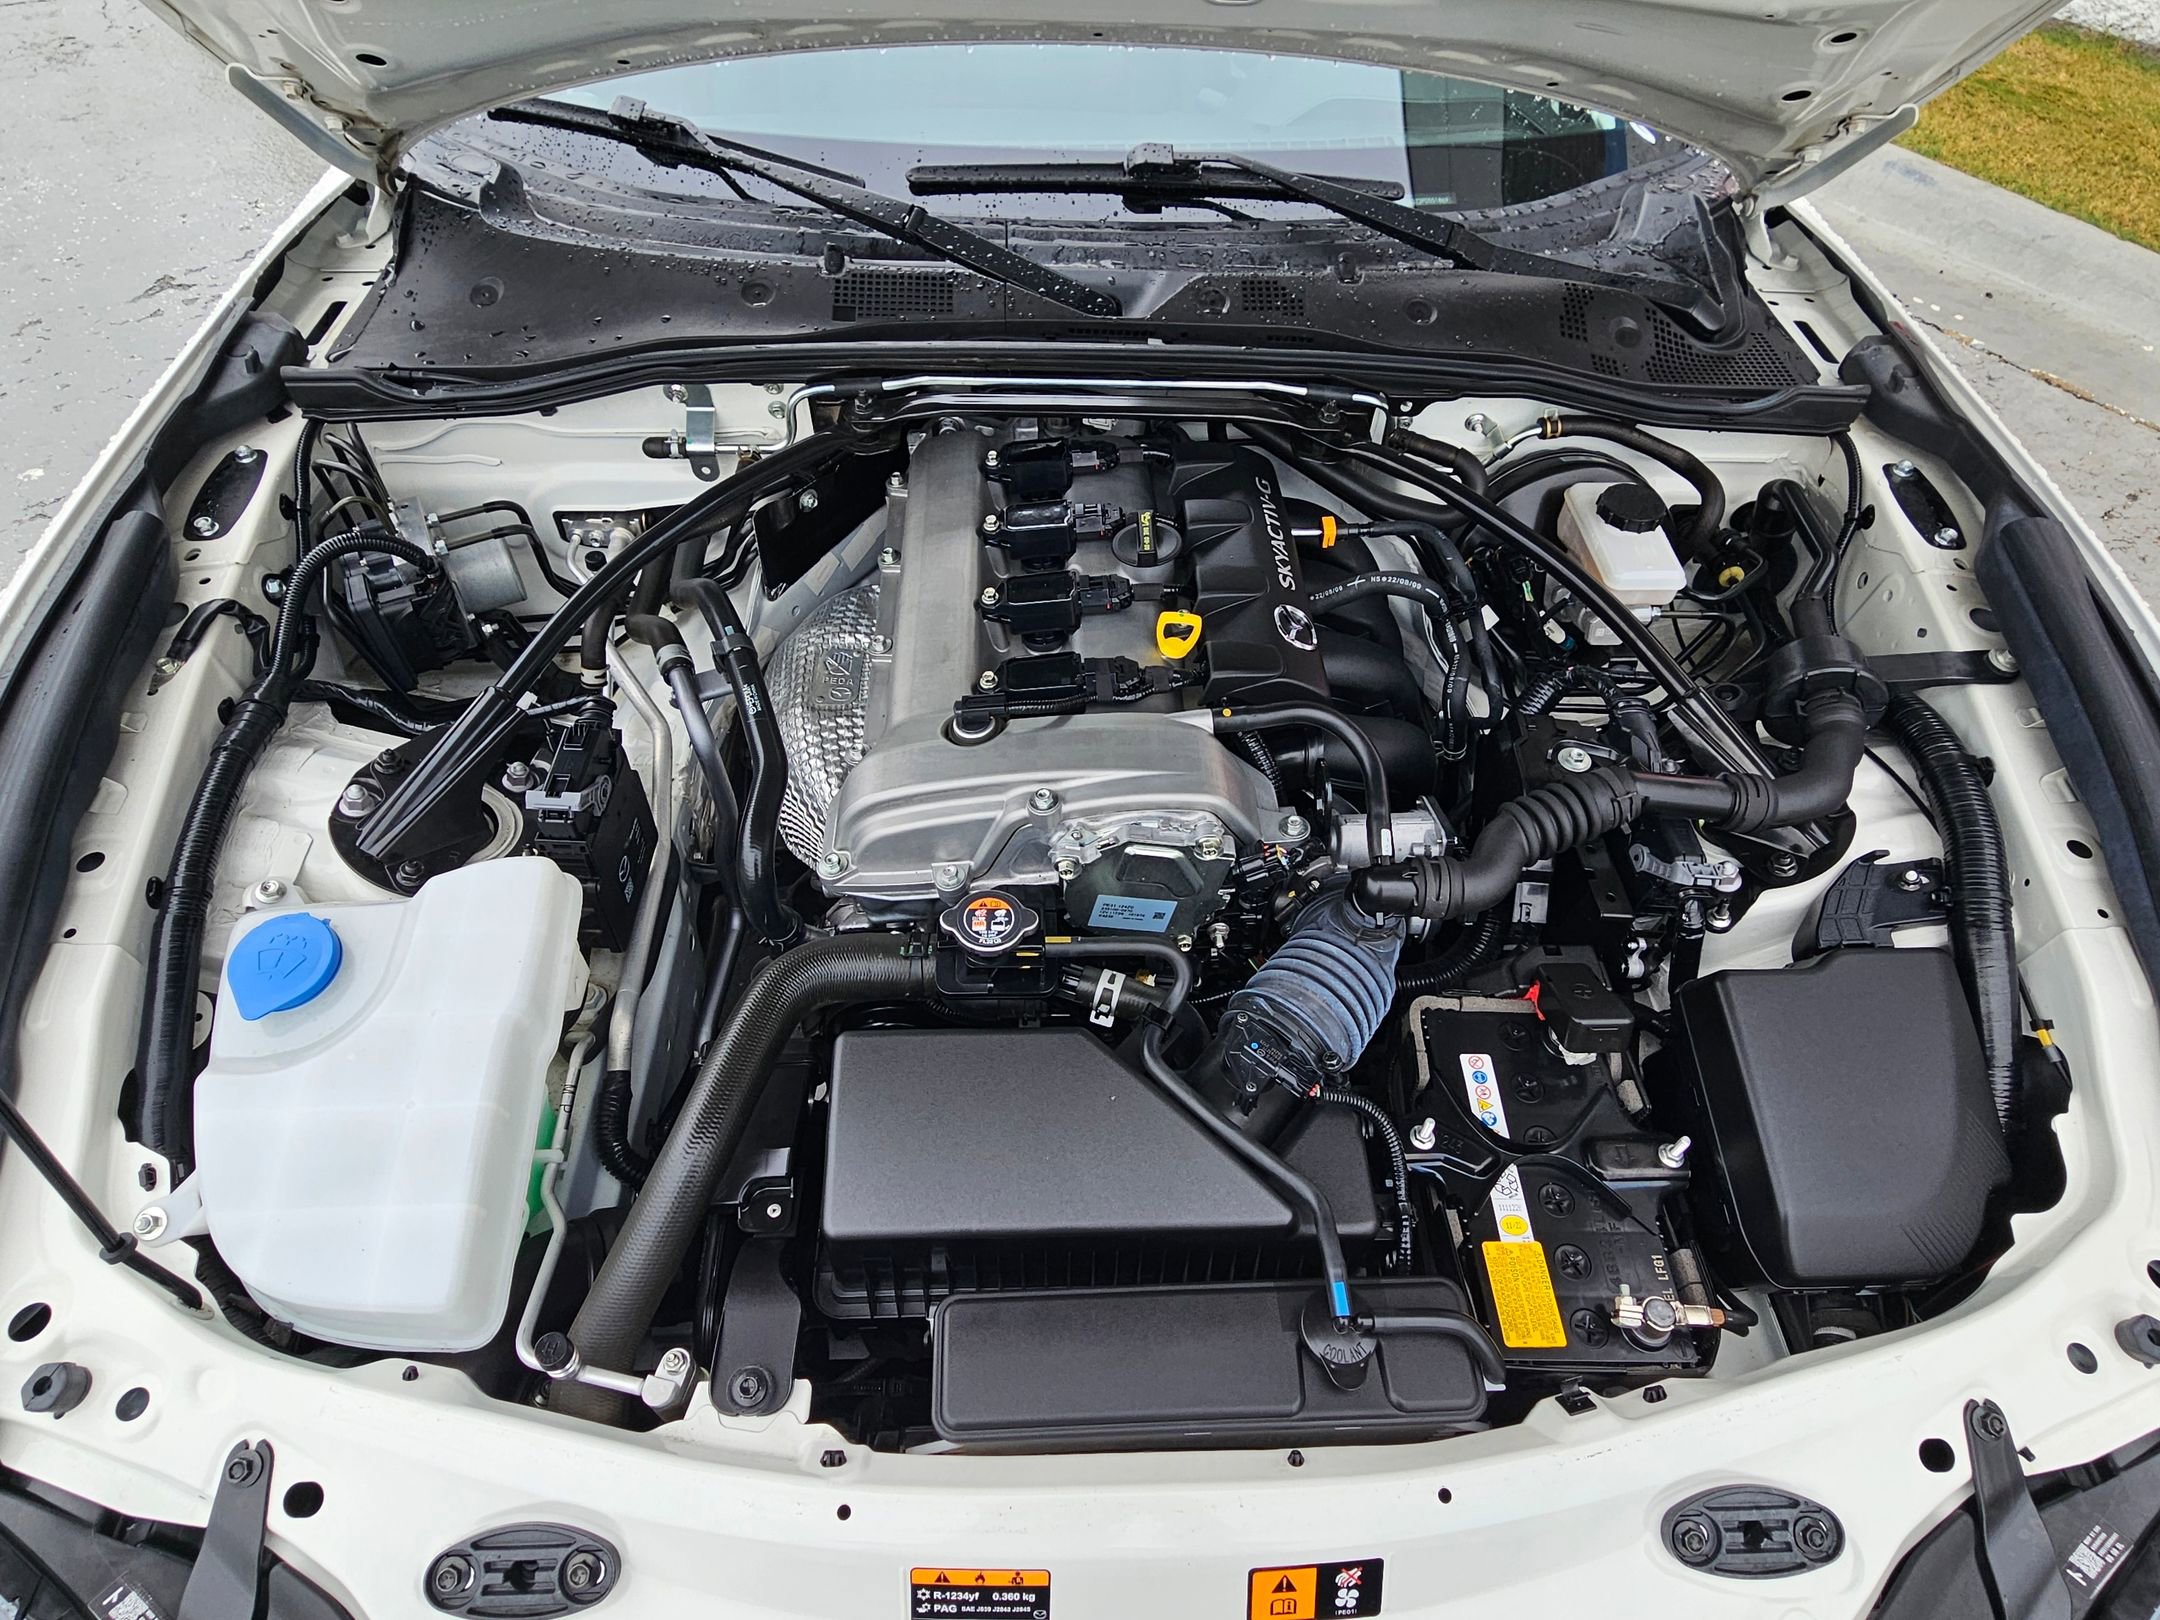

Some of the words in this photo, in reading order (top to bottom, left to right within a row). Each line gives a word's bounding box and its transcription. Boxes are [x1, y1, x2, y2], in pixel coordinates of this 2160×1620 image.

[1255, 477, 1296, 591] SKYACTIV-G
[1507, 1256, 1522, 1282] POISON
[1535, 1259, 1551, 1290] DANGER
[1323, 1342, 1367, 1363] COOLANT
[933, 1591, 979, 1602] R-1234yf
[992, 1592, 1020, 1602] 0.360
[1022, 1592, 1036, 1603] kg
[934, 1604, 957, 1613] PAG
